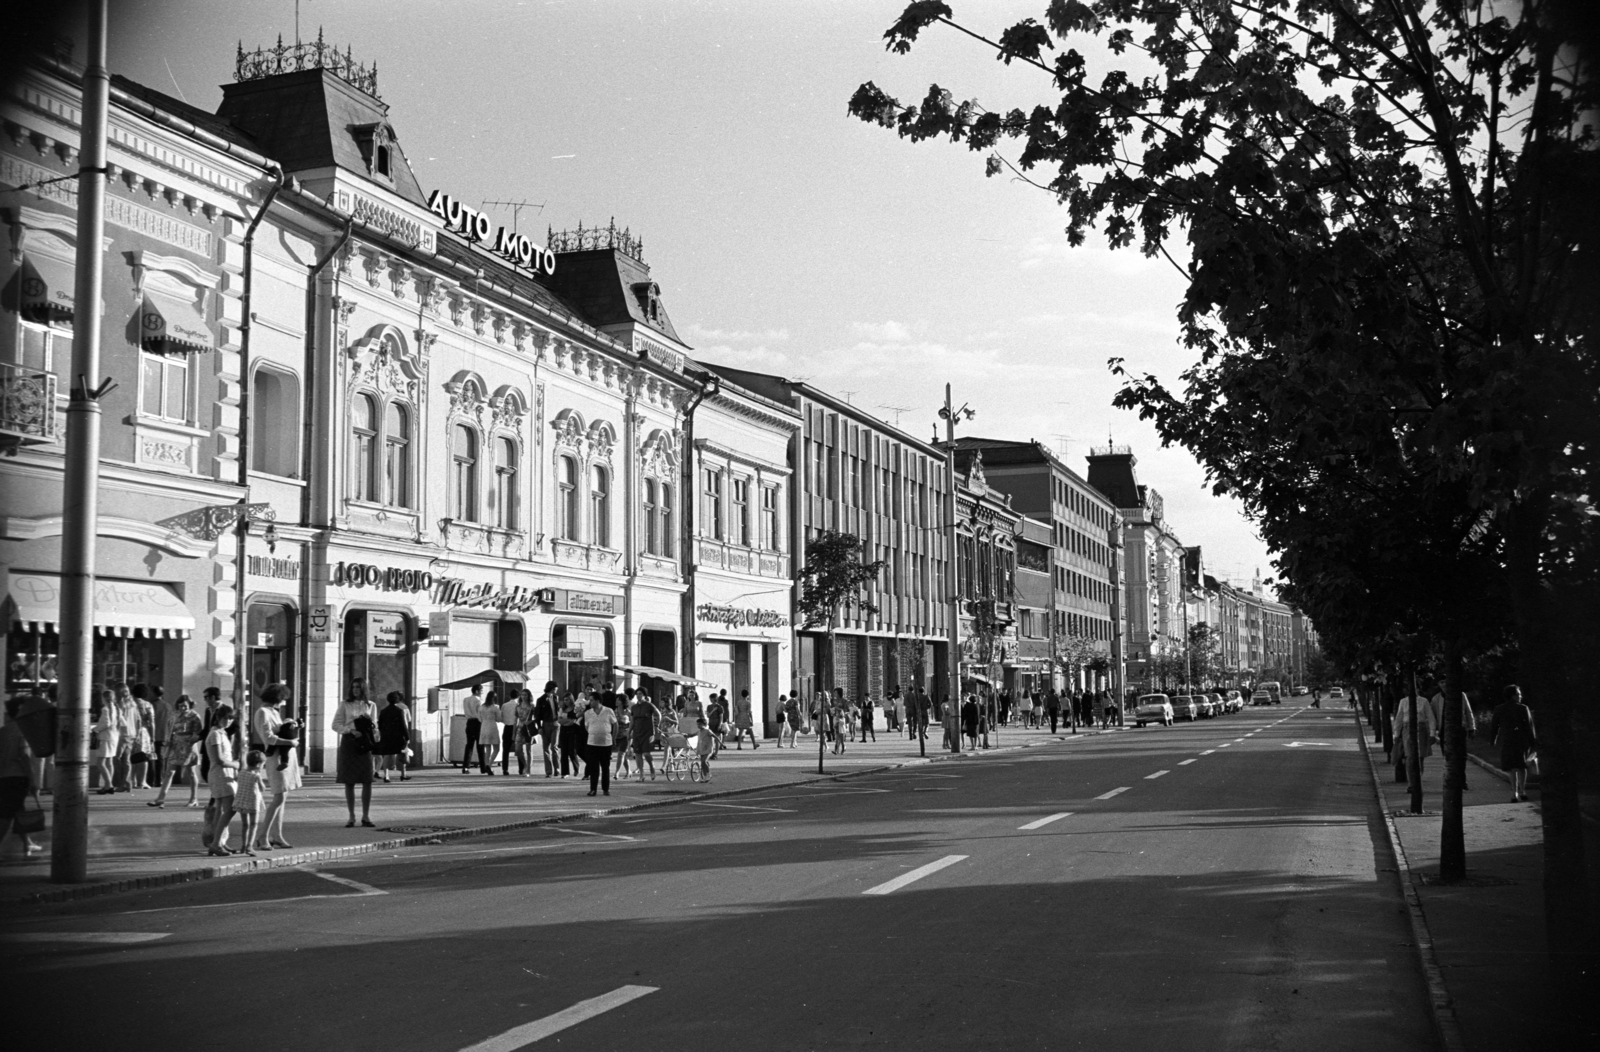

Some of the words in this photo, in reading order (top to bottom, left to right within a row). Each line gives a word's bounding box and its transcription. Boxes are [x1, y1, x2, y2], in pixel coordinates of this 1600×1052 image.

[429, 190, 491, 240] AUTO
[500, 227, 556, 276] MOTO
[337, 561, 382, 587] LOTO
[569, 594, 613, 613] alimente
